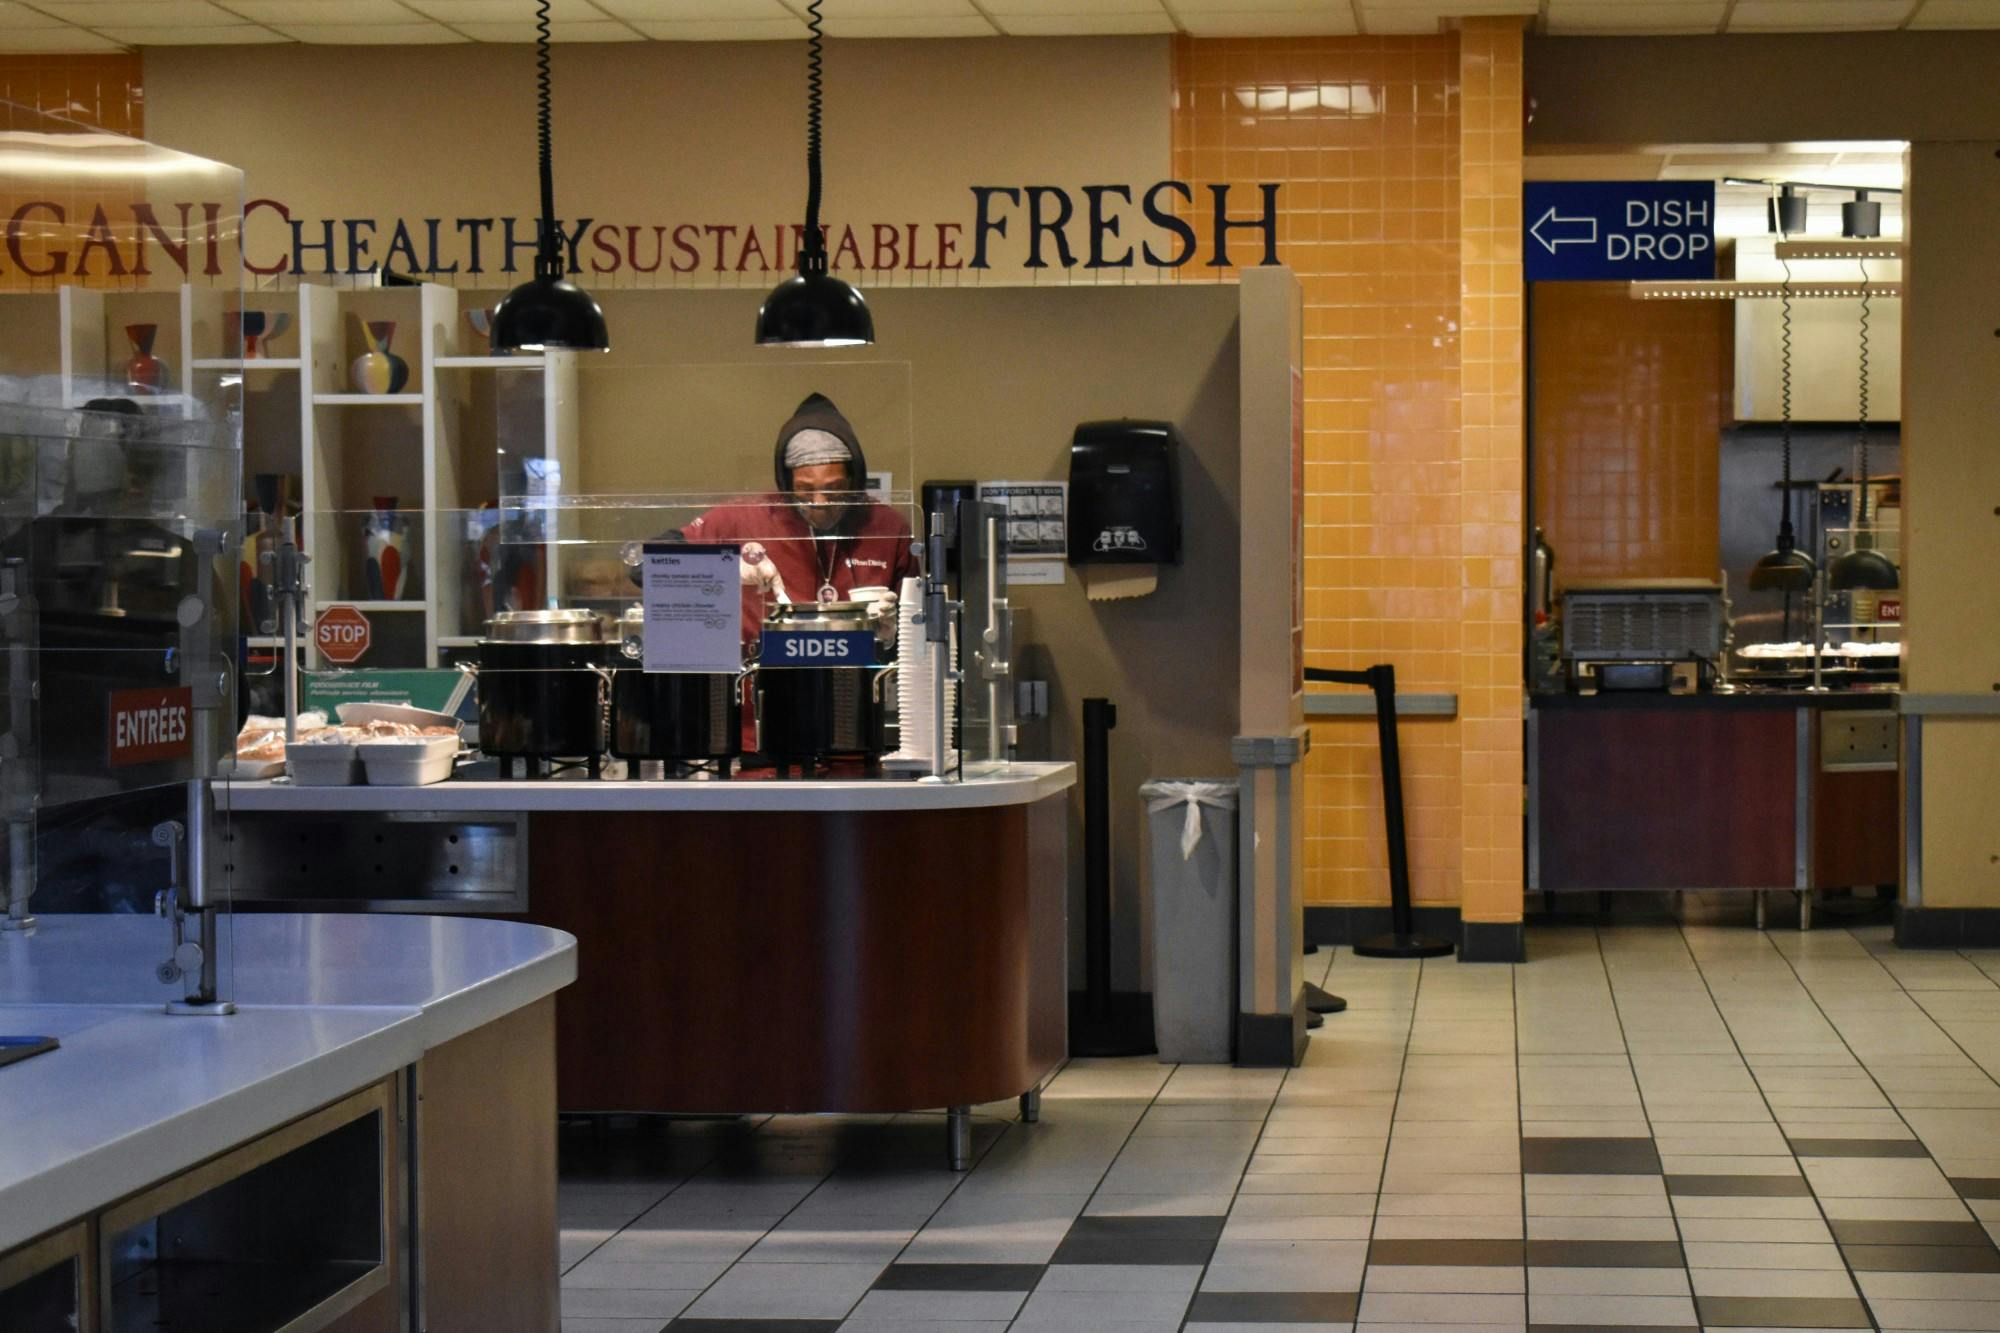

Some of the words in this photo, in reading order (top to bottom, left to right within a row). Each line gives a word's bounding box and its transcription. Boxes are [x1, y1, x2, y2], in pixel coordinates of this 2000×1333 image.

[1626, 200, 1707, 227] DISH
[0, 199, 289, 276] GANIC
[288, 217, 594, 275] HEALTHY
[968, 180, 1282, 269] FRESH
[1607, 233, 1709, 260] DROP
[320, 624, 364, 643] STOP
[786, 638, 849, 657] SIDES
[116, 697, 186, 748] ENTRÉES
